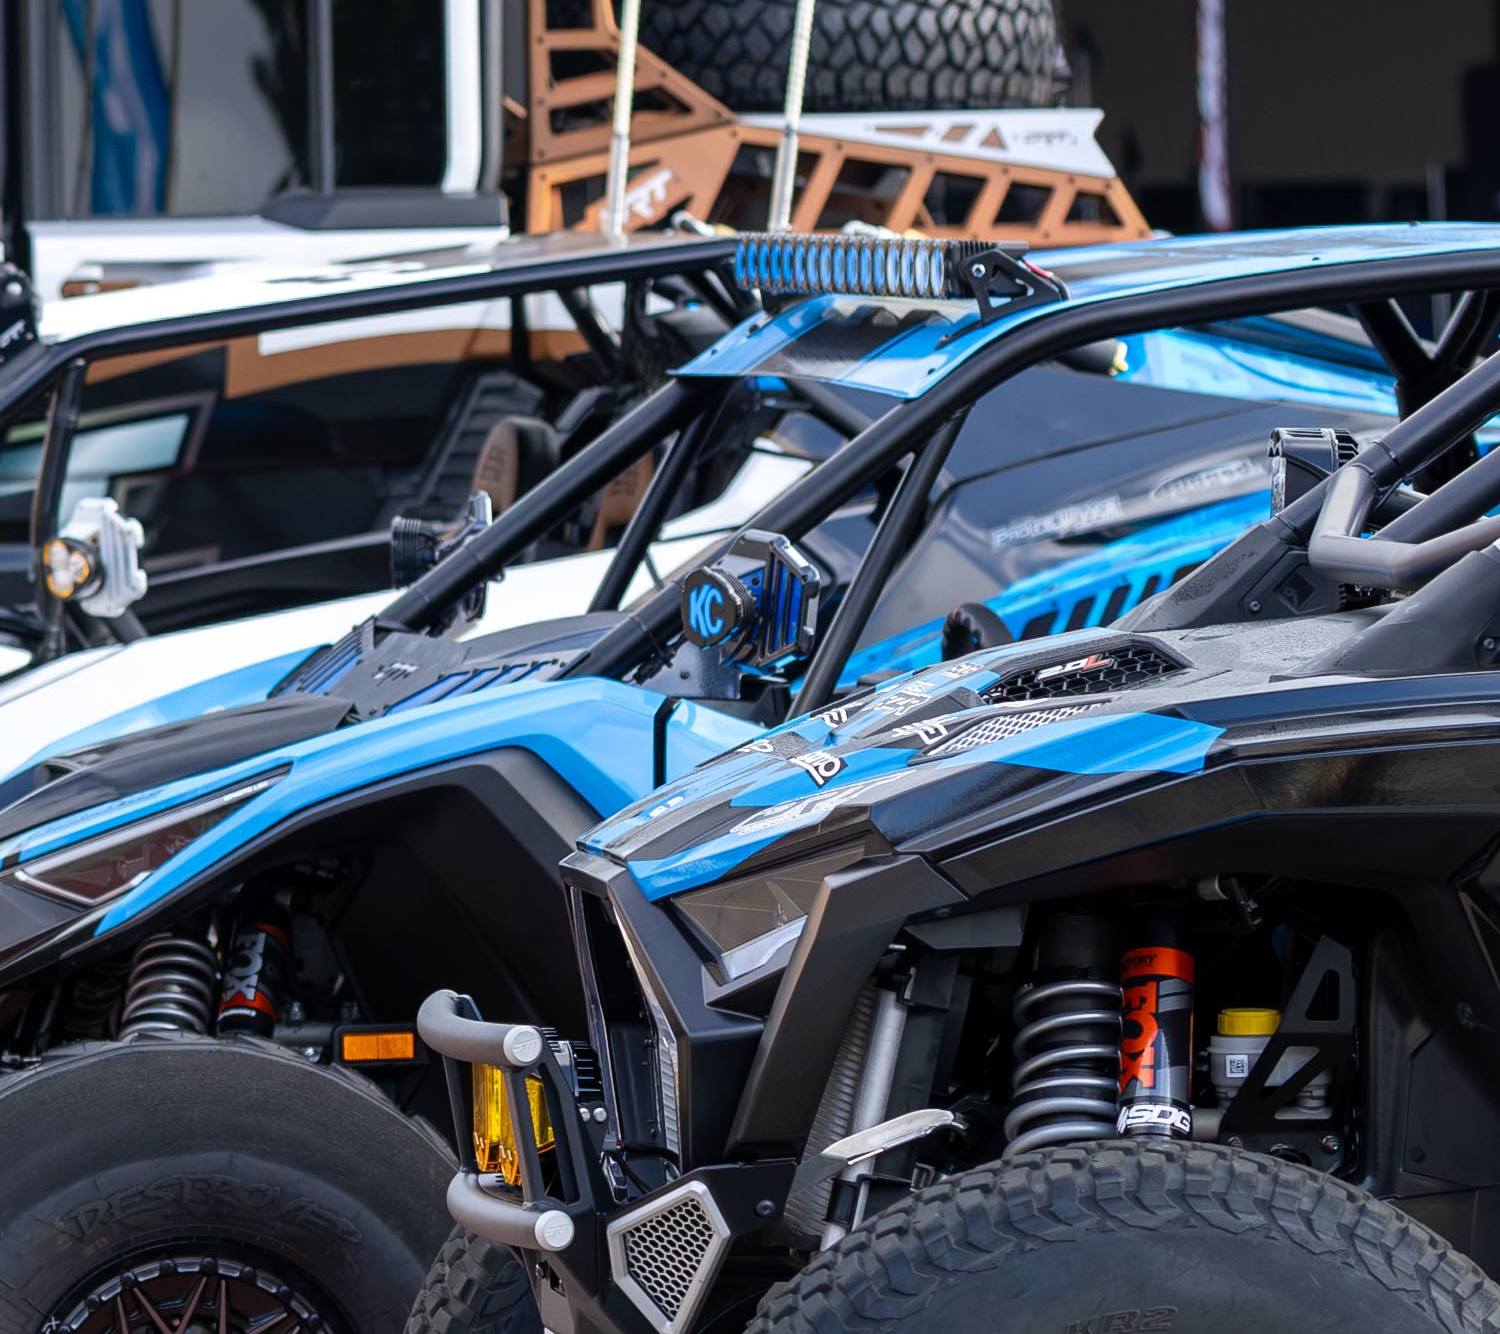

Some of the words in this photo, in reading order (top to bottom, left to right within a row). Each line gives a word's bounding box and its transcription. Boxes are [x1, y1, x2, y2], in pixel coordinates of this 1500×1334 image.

[690, 584, 724, 638] KC
[222, 931, 267, 1003] FOX
[1119, 981, 1159, 1095] FOX
